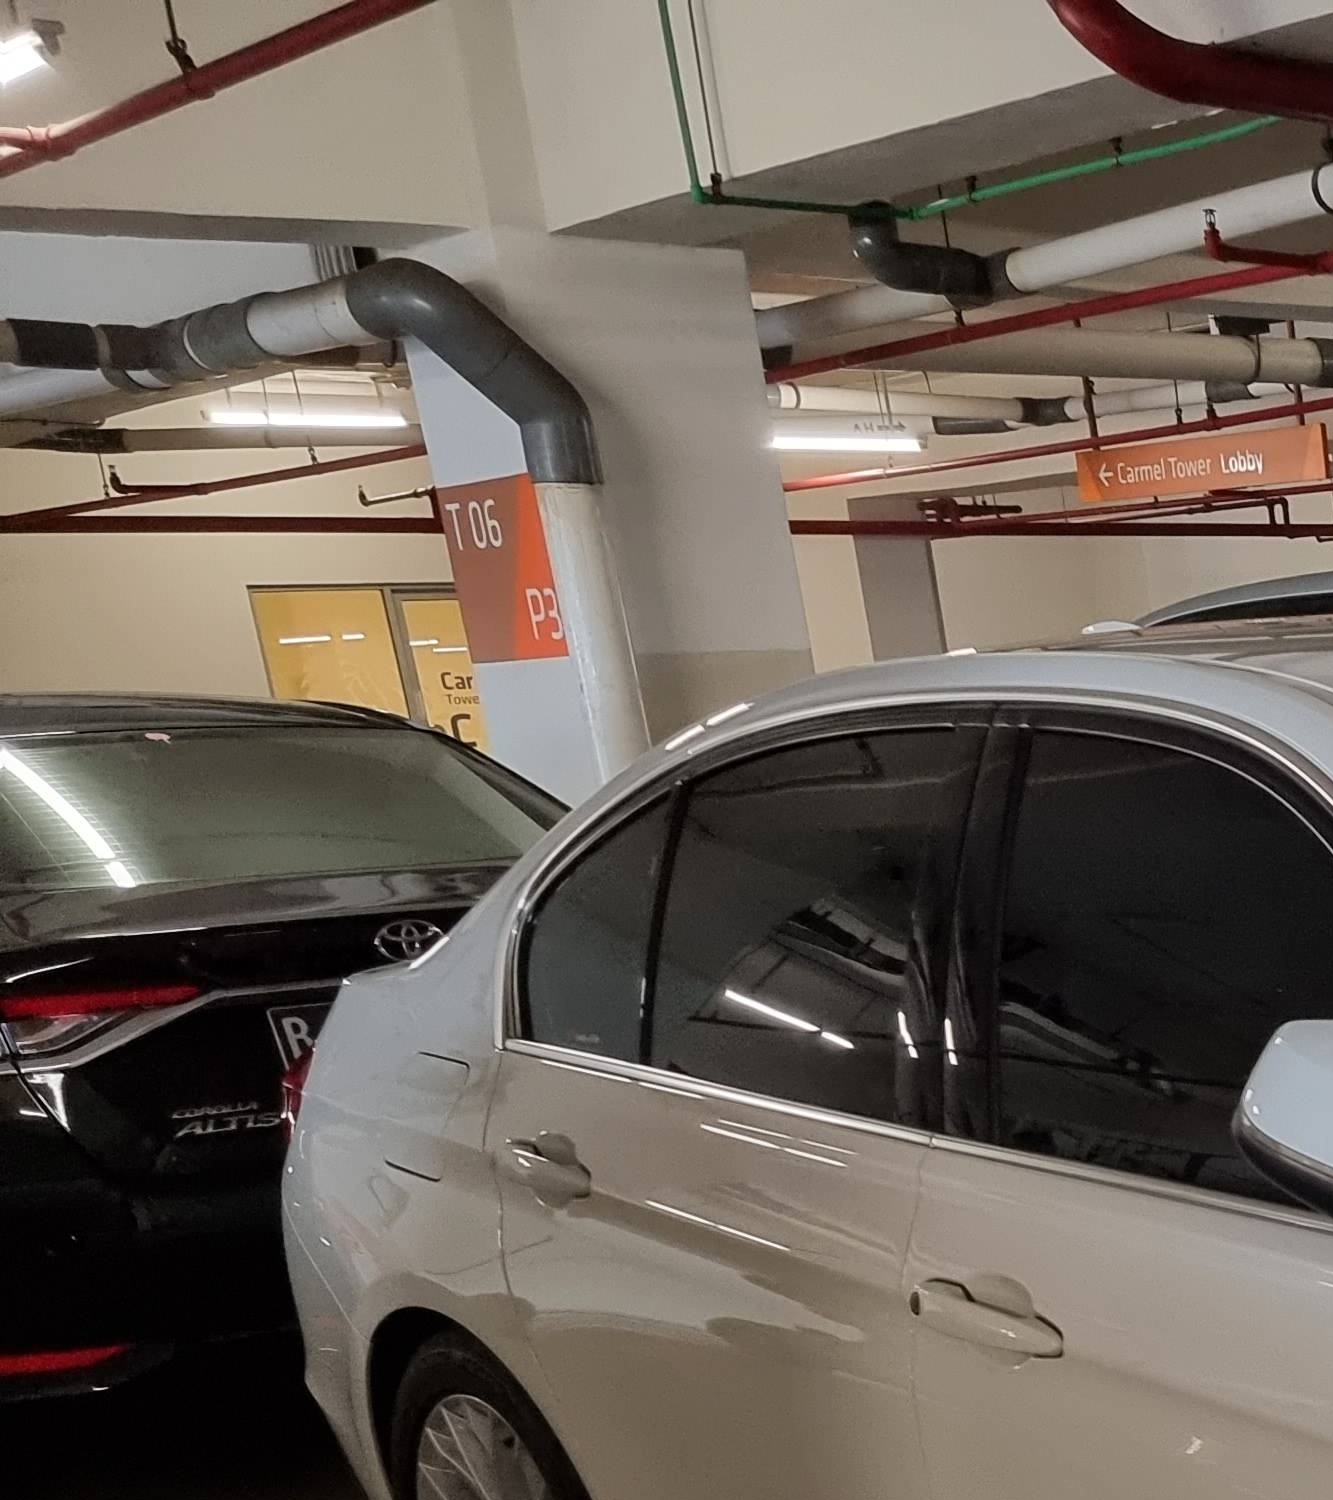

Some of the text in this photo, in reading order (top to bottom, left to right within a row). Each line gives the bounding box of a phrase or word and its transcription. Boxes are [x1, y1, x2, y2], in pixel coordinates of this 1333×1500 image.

[1117, 449, 1264, 485] Carmel Tower Lobby
[445, 499, 503, 551] T 06
[525, 587, 564, 641] P3
[174, 1111, 281, 1138] ALTIS
